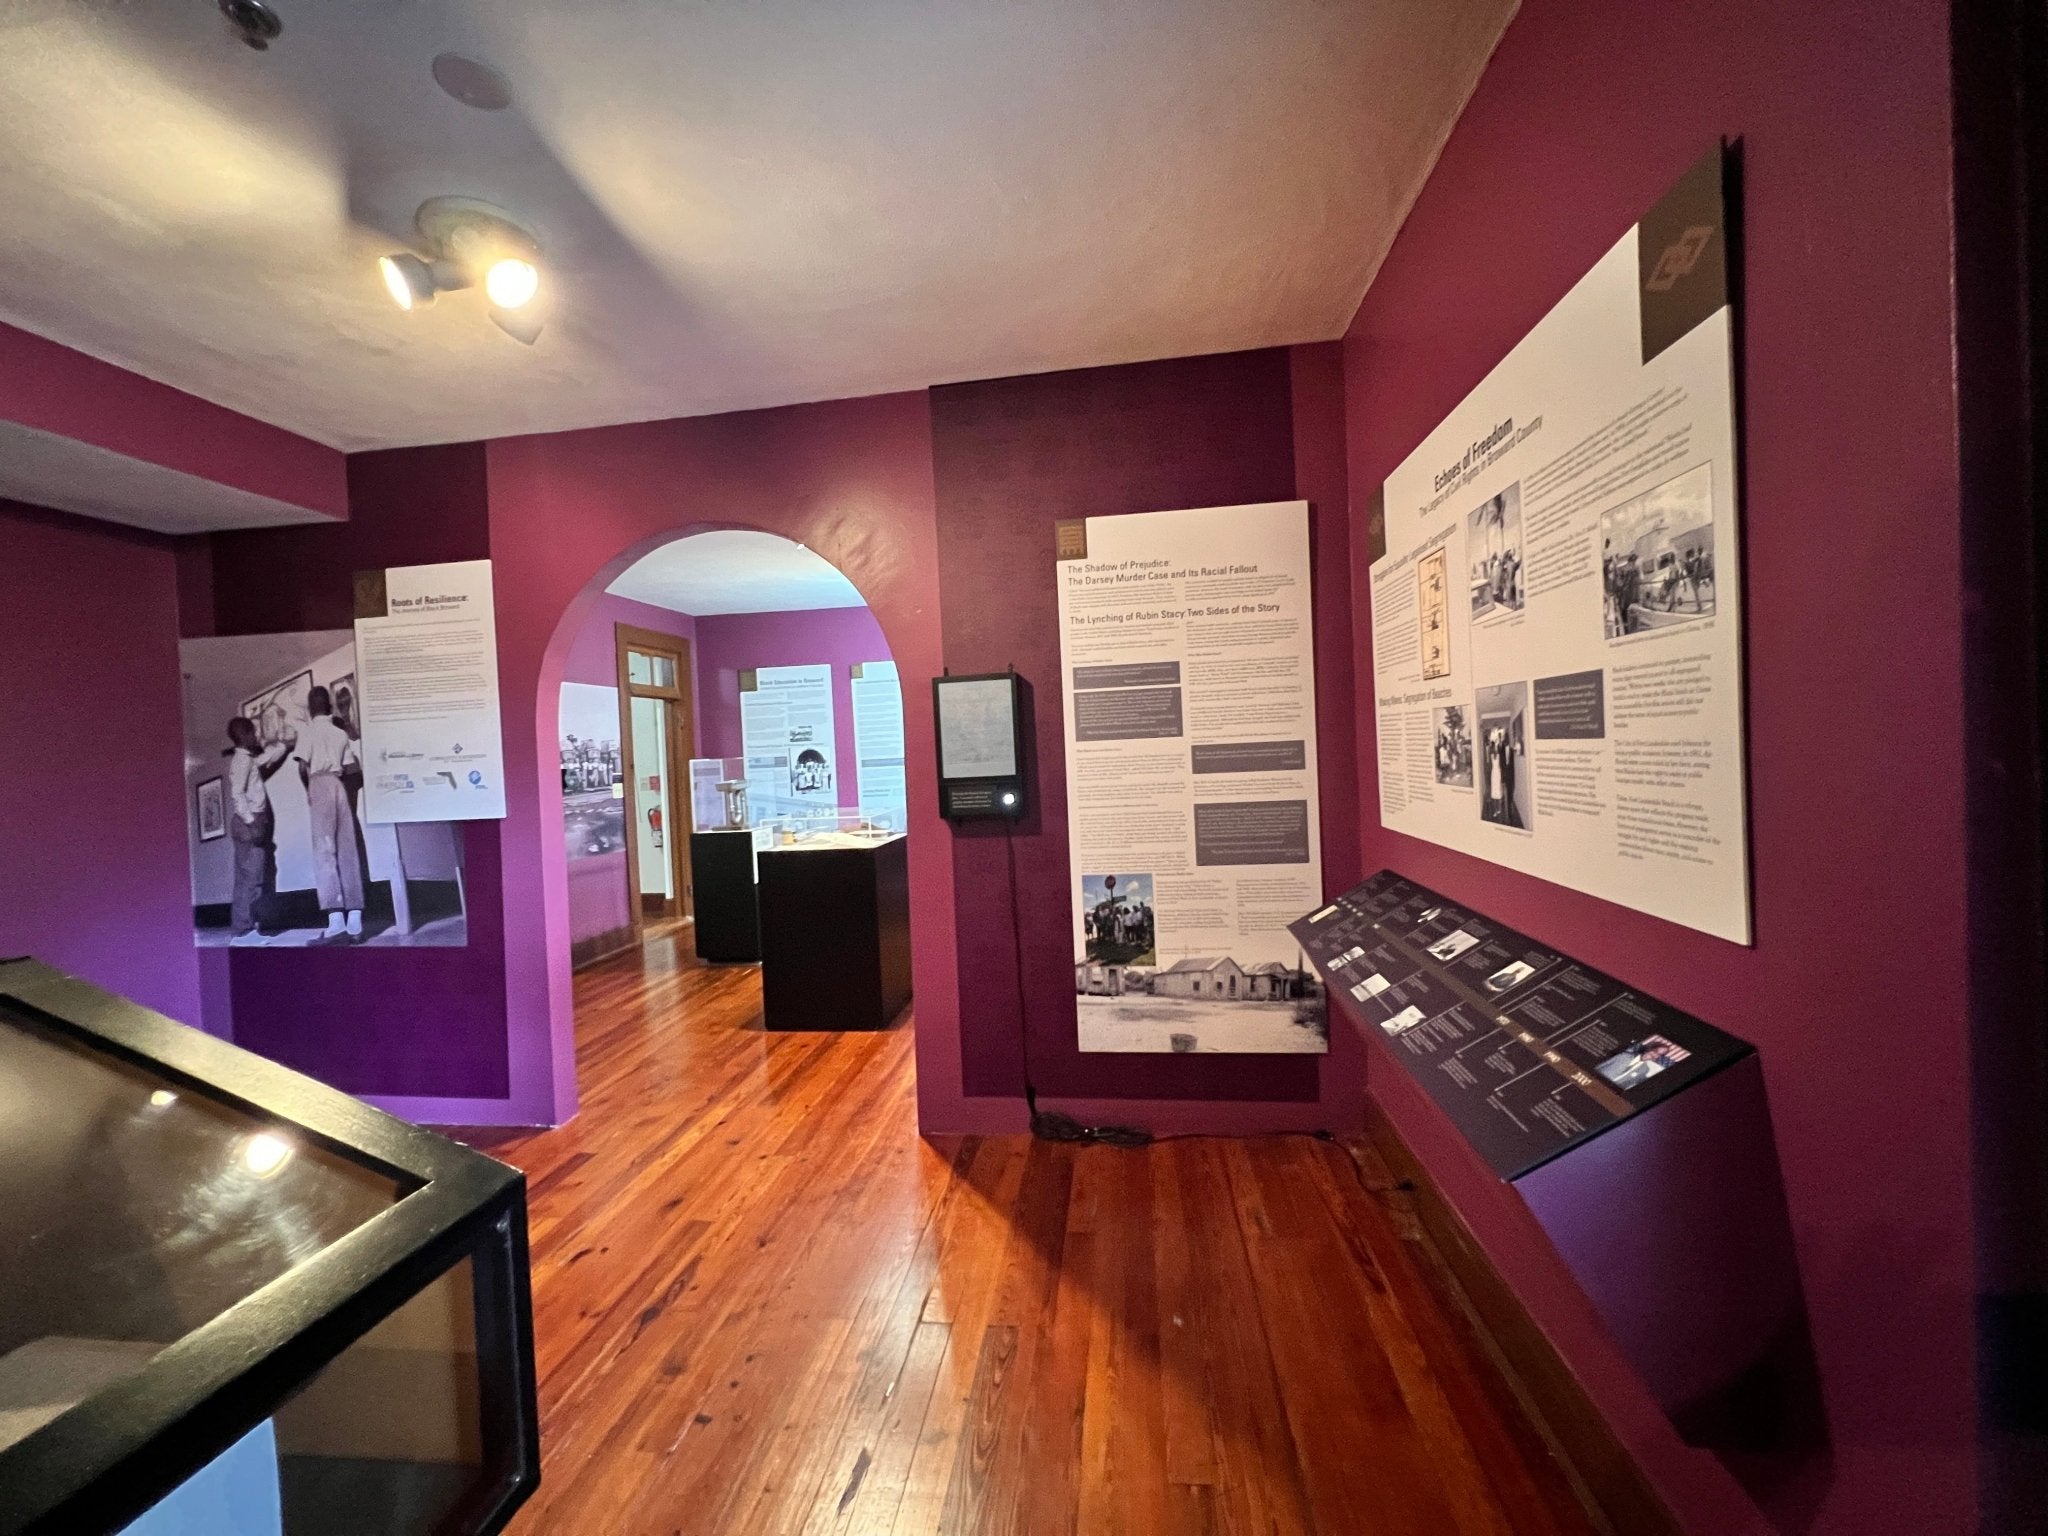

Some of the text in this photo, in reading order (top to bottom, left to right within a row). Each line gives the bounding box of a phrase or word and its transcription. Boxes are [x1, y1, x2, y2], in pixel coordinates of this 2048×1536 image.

[1516, 414, 1543, 444] County
[1434, 417, 1513, 493] Echoes of Freedom
[1068, 565, 1083, 574] The
[1084, 563, 1118, 573] Shadow
[1119, 561, 1128, 570] of
[1068, 564, 1258, 586] The Darsey Murder Case and Its Racial Fallout
[415, 596, 422, 605] of
[1070, 616, 1085, 625] The
[1087, 614, 1124, 624] Lynching
[1125, 612, 1134, 621] of
[1135, 611, 1159, 620] Rubin
[1187, 608, 1204, 617] Two
[1206, 606, 1230, 616] Sides
[1231, 605, 1240, 614] of
[1241, 604, 1255, 613] the
[1257, 603, 1280, 613] Story
